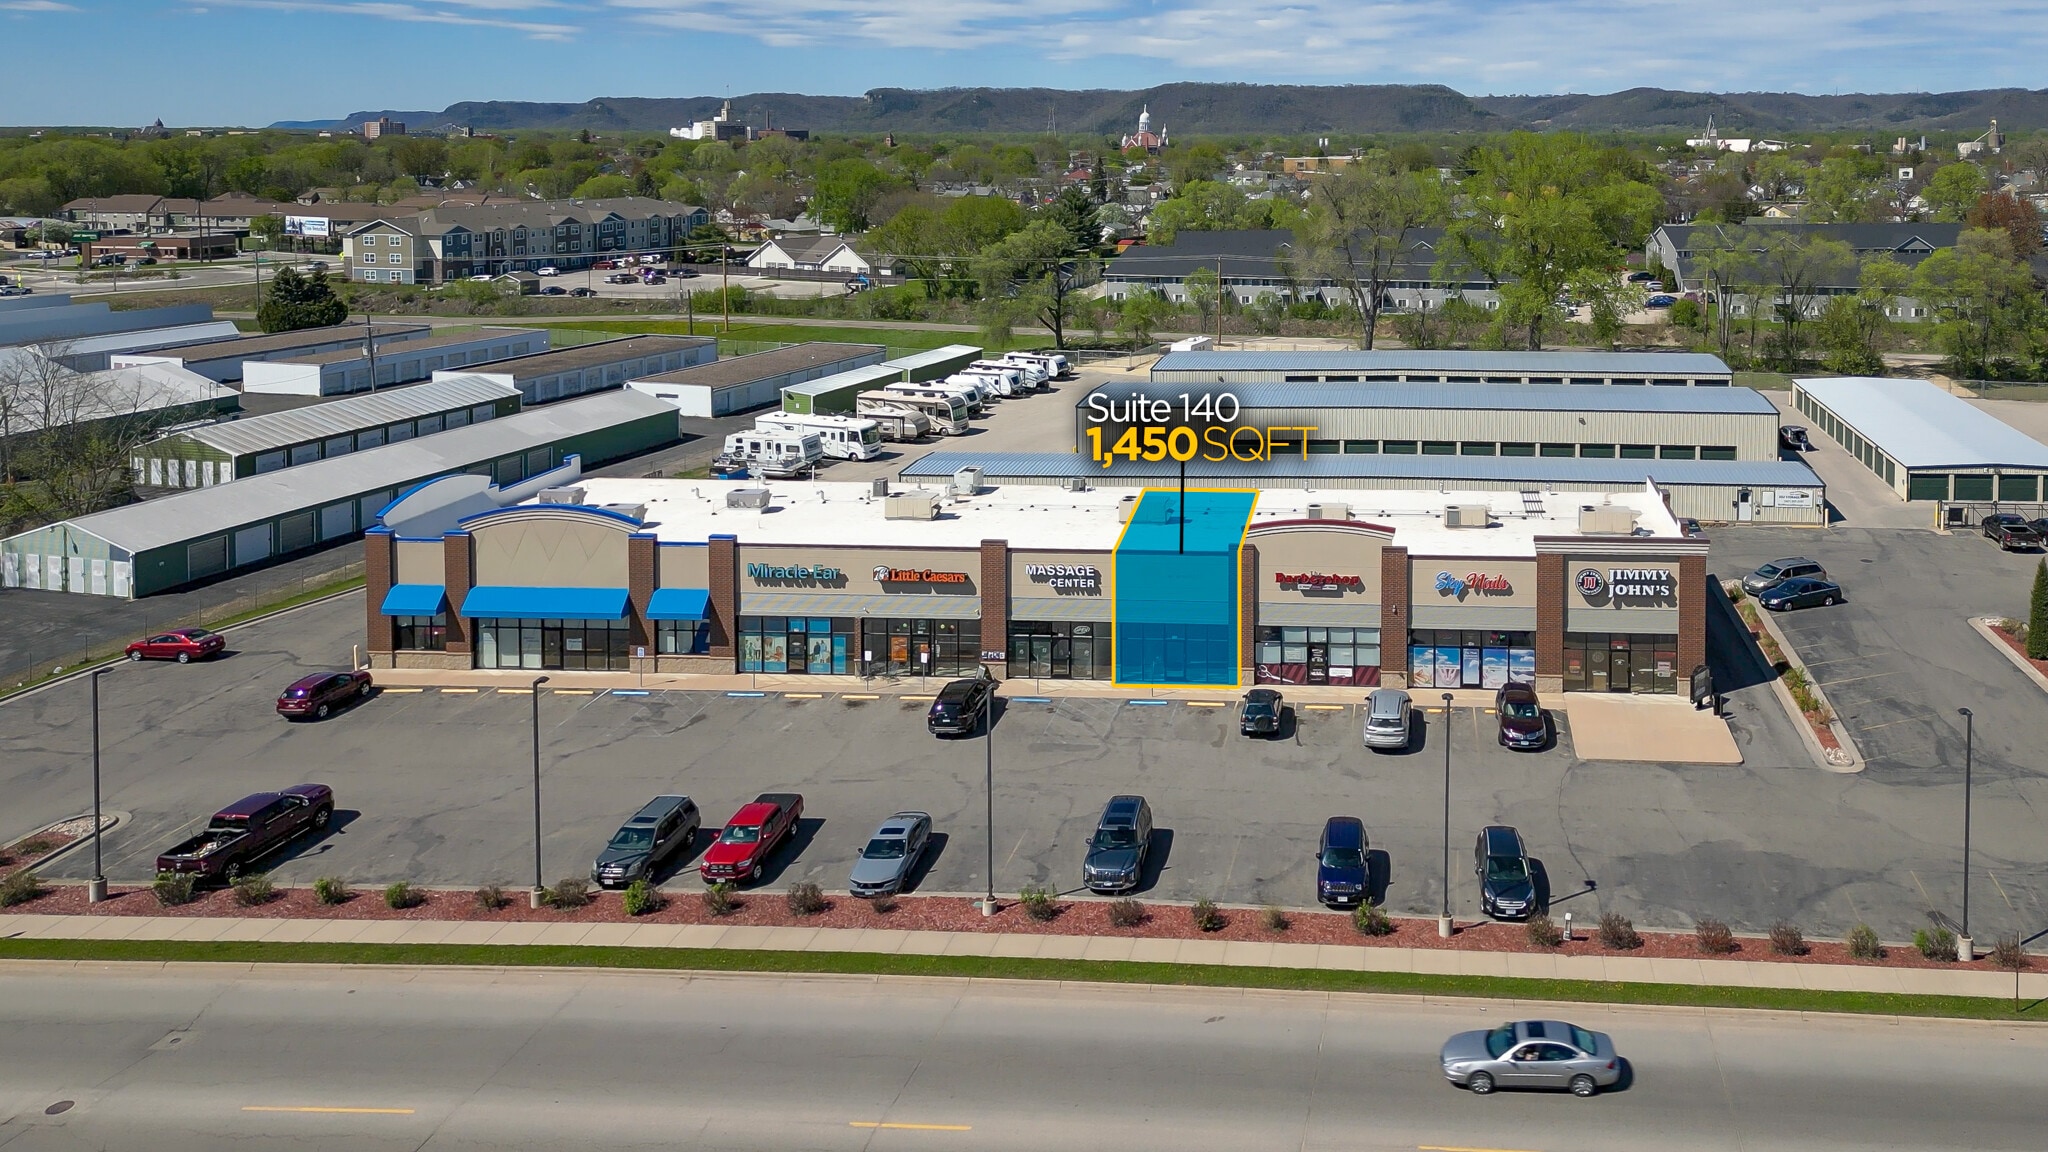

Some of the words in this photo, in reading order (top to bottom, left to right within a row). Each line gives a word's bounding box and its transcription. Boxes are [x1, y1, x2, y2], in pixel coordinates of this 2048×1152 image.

[890, 569, 921, 582] Little
[922, 569, 966, 583] Caesars
[1025, 564, 1095, 577] MASSAGE
[1608, 569, 1670, 583] JIMMY
[1049, 578, 1095, 588] CENTER
[1275, 572, 1361, 586] Barbershop
[1434, 570, 1465, 596] Sky
[1466, 571, 1509, 590] Nails
[1583, 576, 1597, 589] JJ
[1608, 584, 1670, 598] JOHN'S
